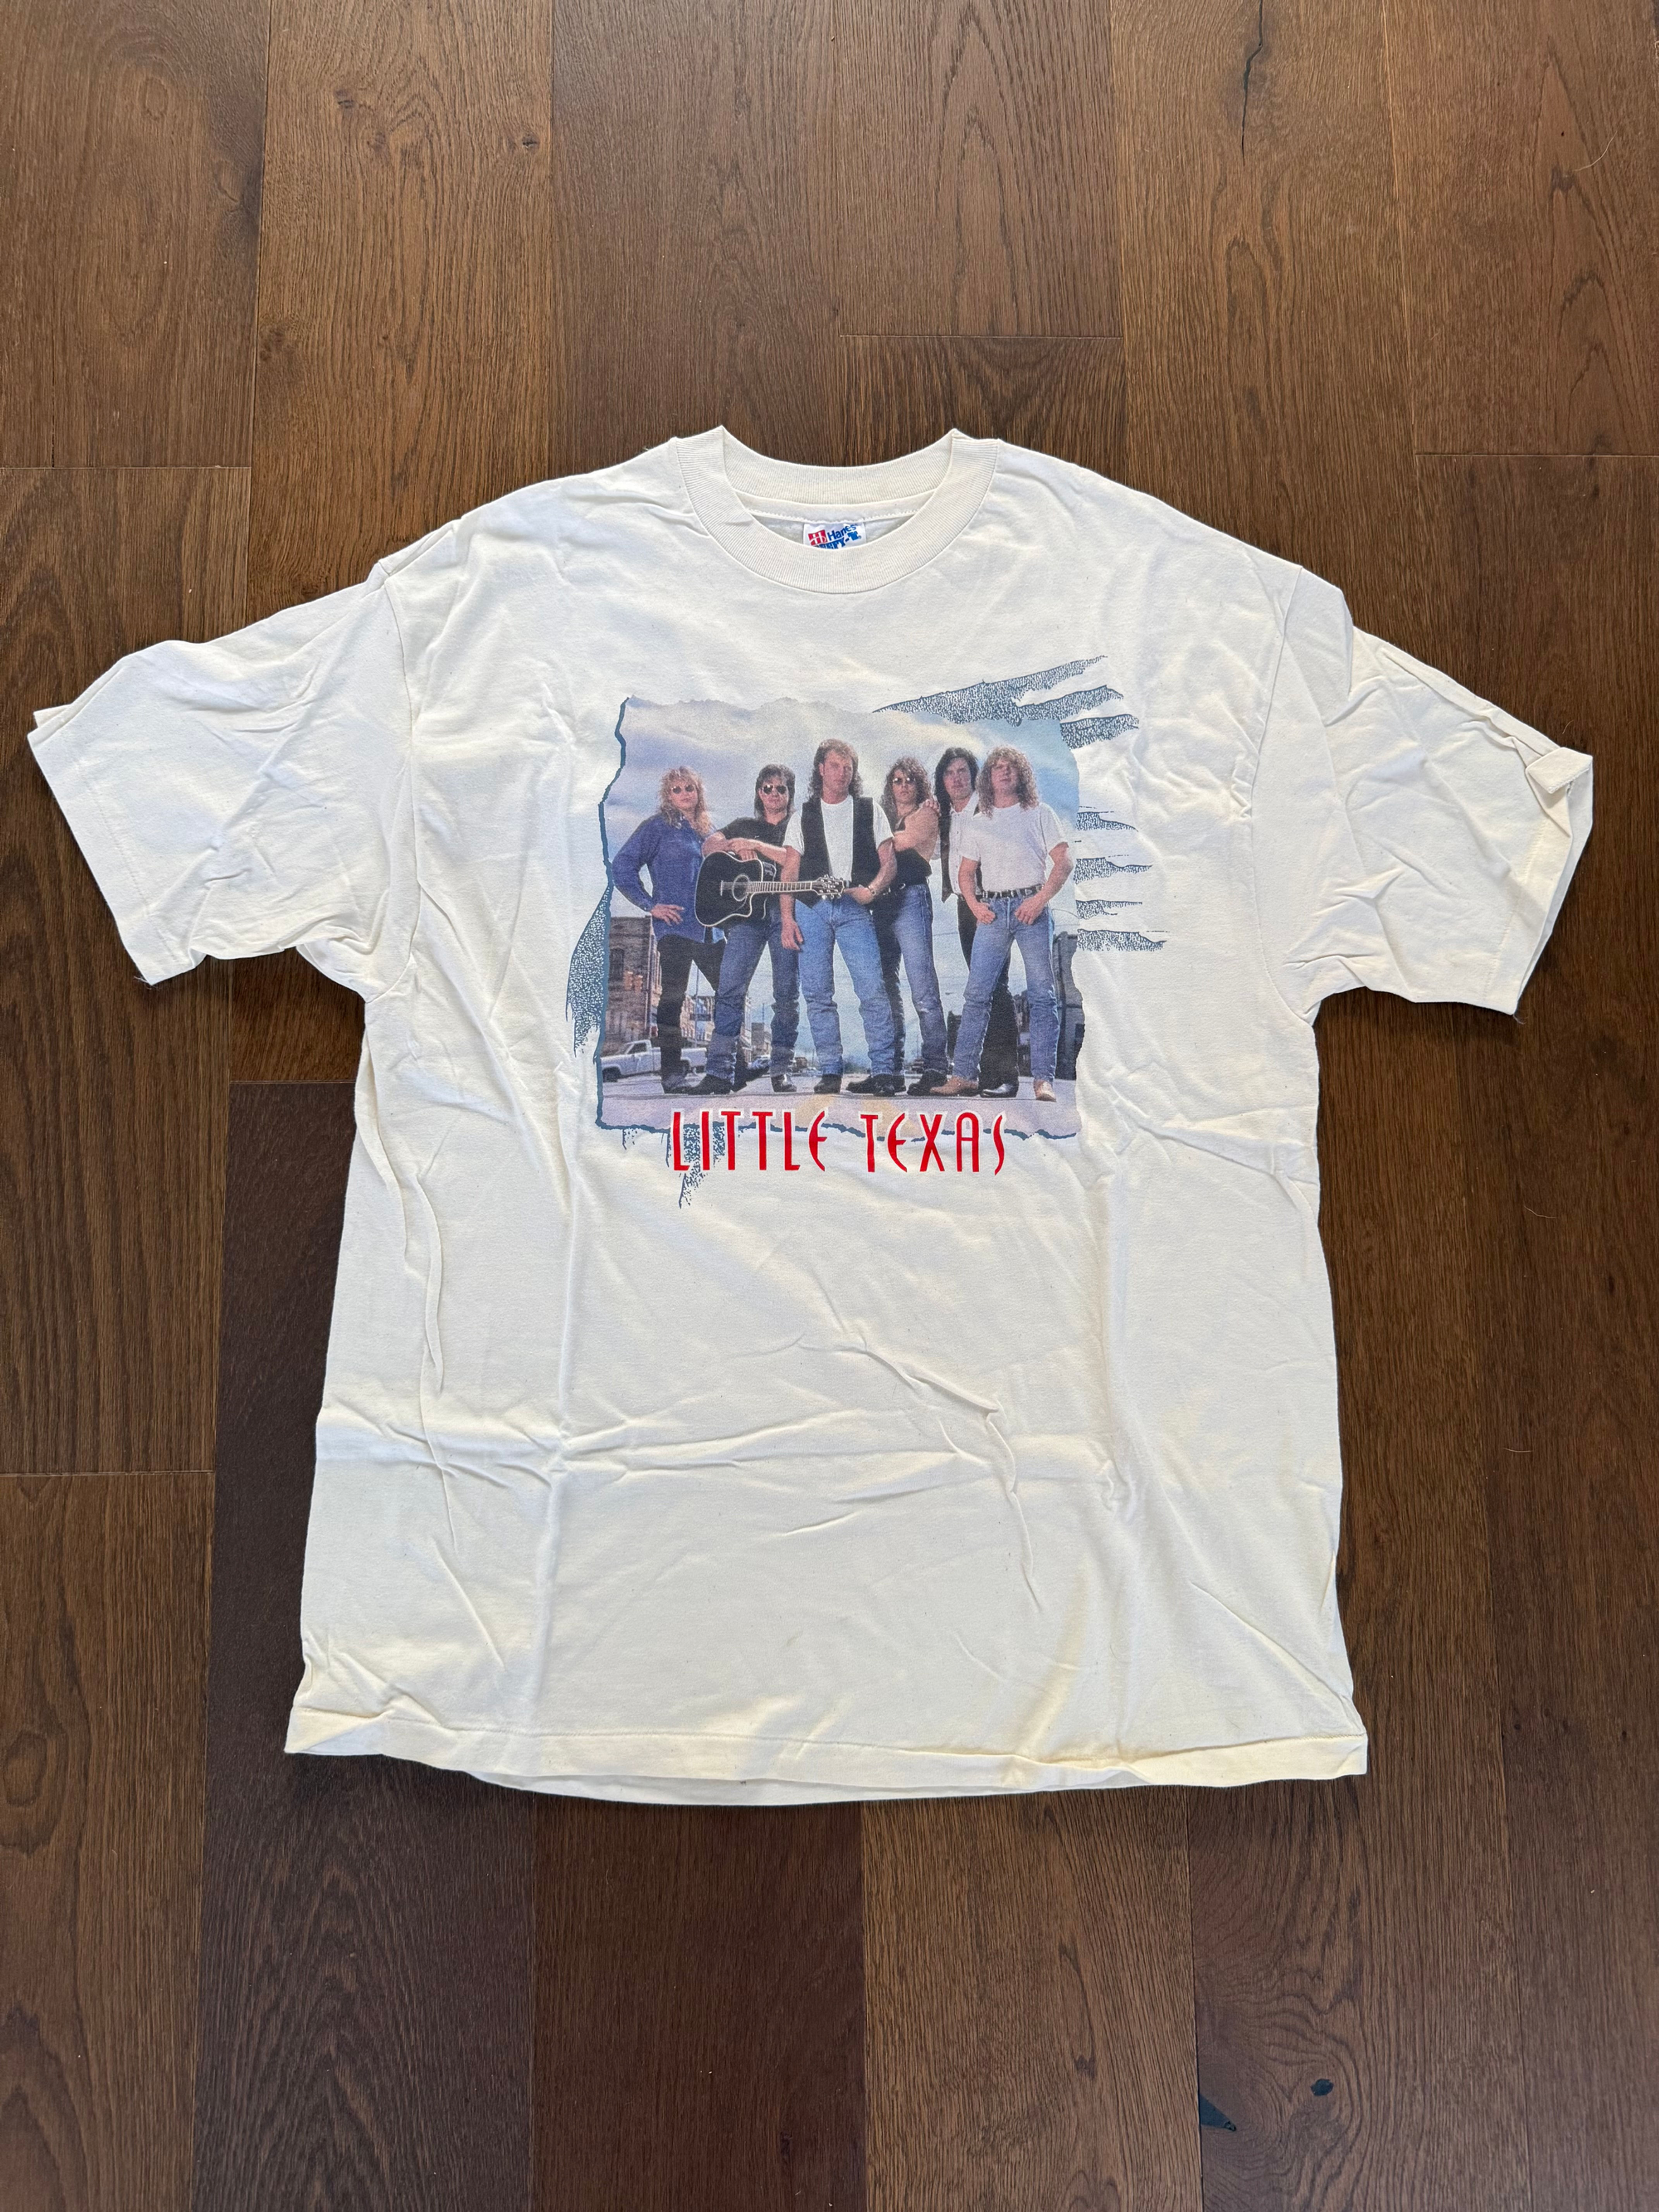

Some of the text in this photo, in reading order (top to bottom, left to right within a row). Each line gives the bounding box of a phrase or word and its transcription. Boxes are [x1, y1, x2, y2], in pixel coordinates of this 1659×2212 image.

[827, 524, 856, 541] Hanes
[672, 1111, 1005, 1175] LITTLE TEXAS
